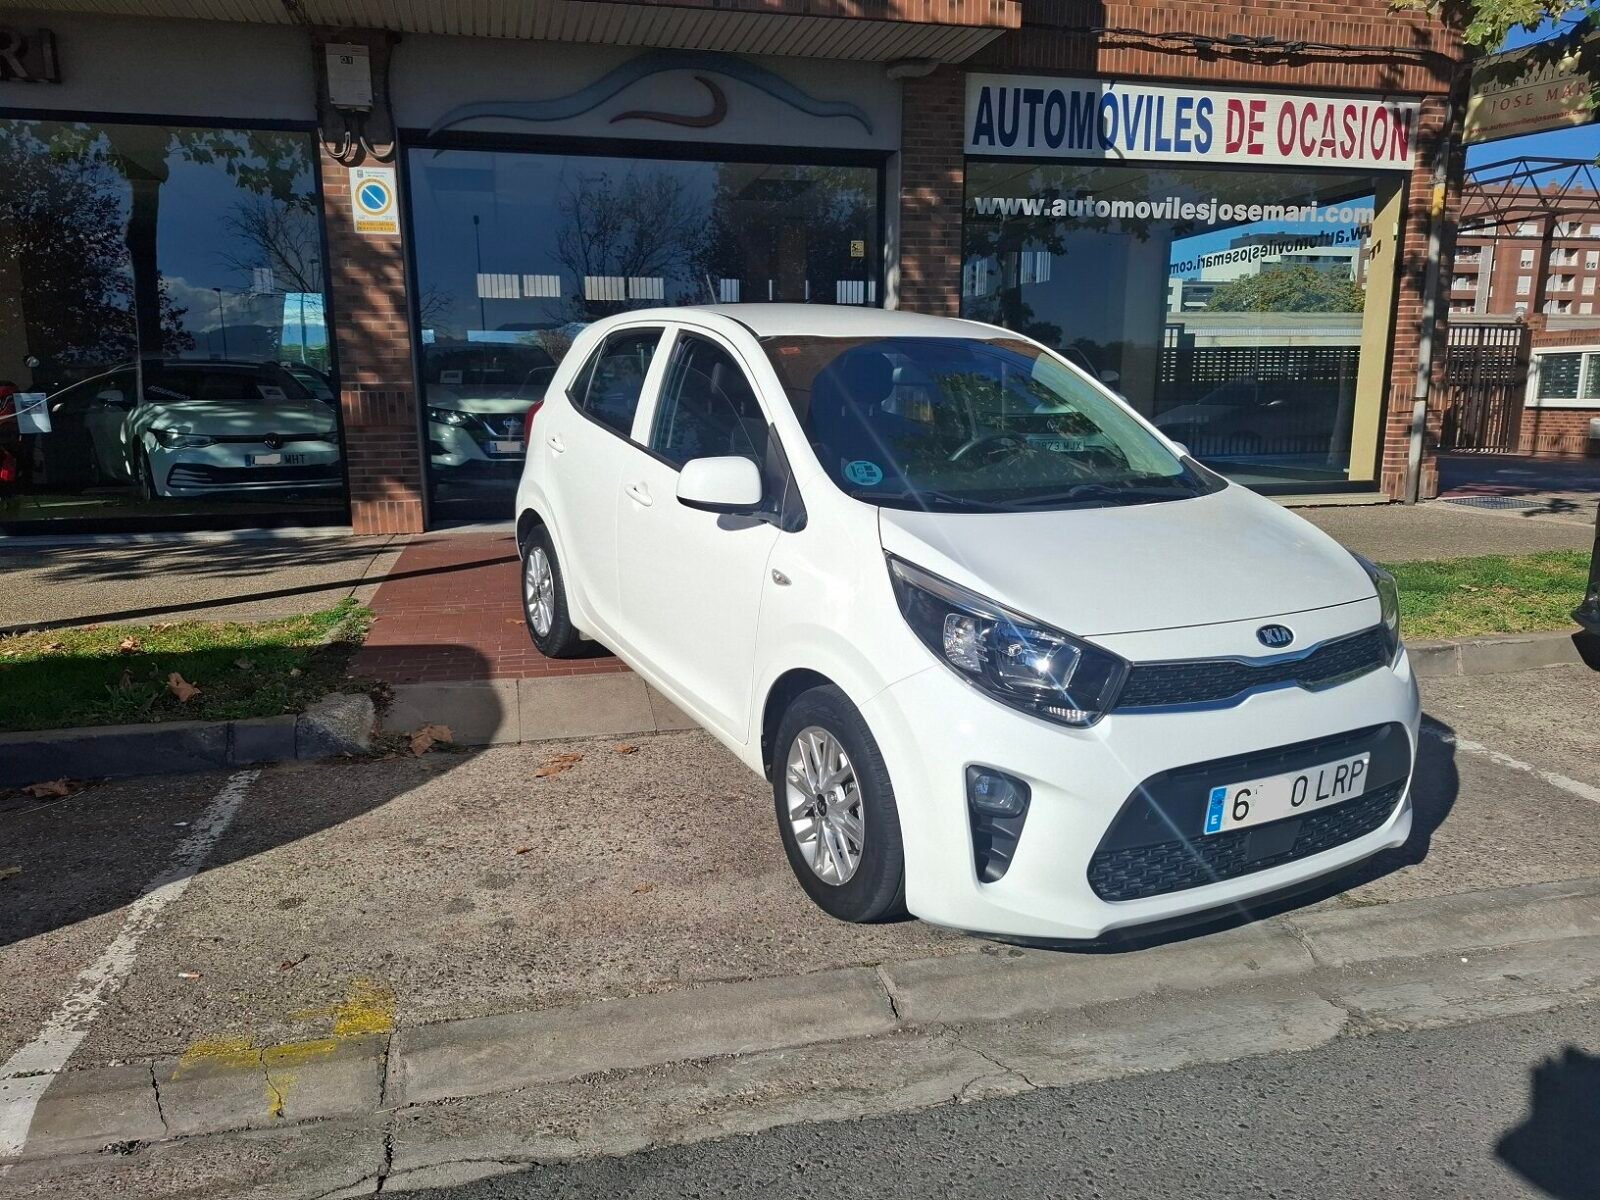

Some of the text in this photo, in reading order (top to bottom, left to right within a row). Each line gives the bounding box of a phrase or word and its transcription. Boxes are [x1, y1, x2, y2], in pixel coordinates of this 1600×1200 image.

[972, 80, 1214, 154] AUTOMÓVILES
[1225, 99, 1267, 155] DE
[974, 196, 1375, 225] www.automovilesjosemari.com
[1262, 627, 1291, 643] KIA
[1211, 815, 1218, 824] E
